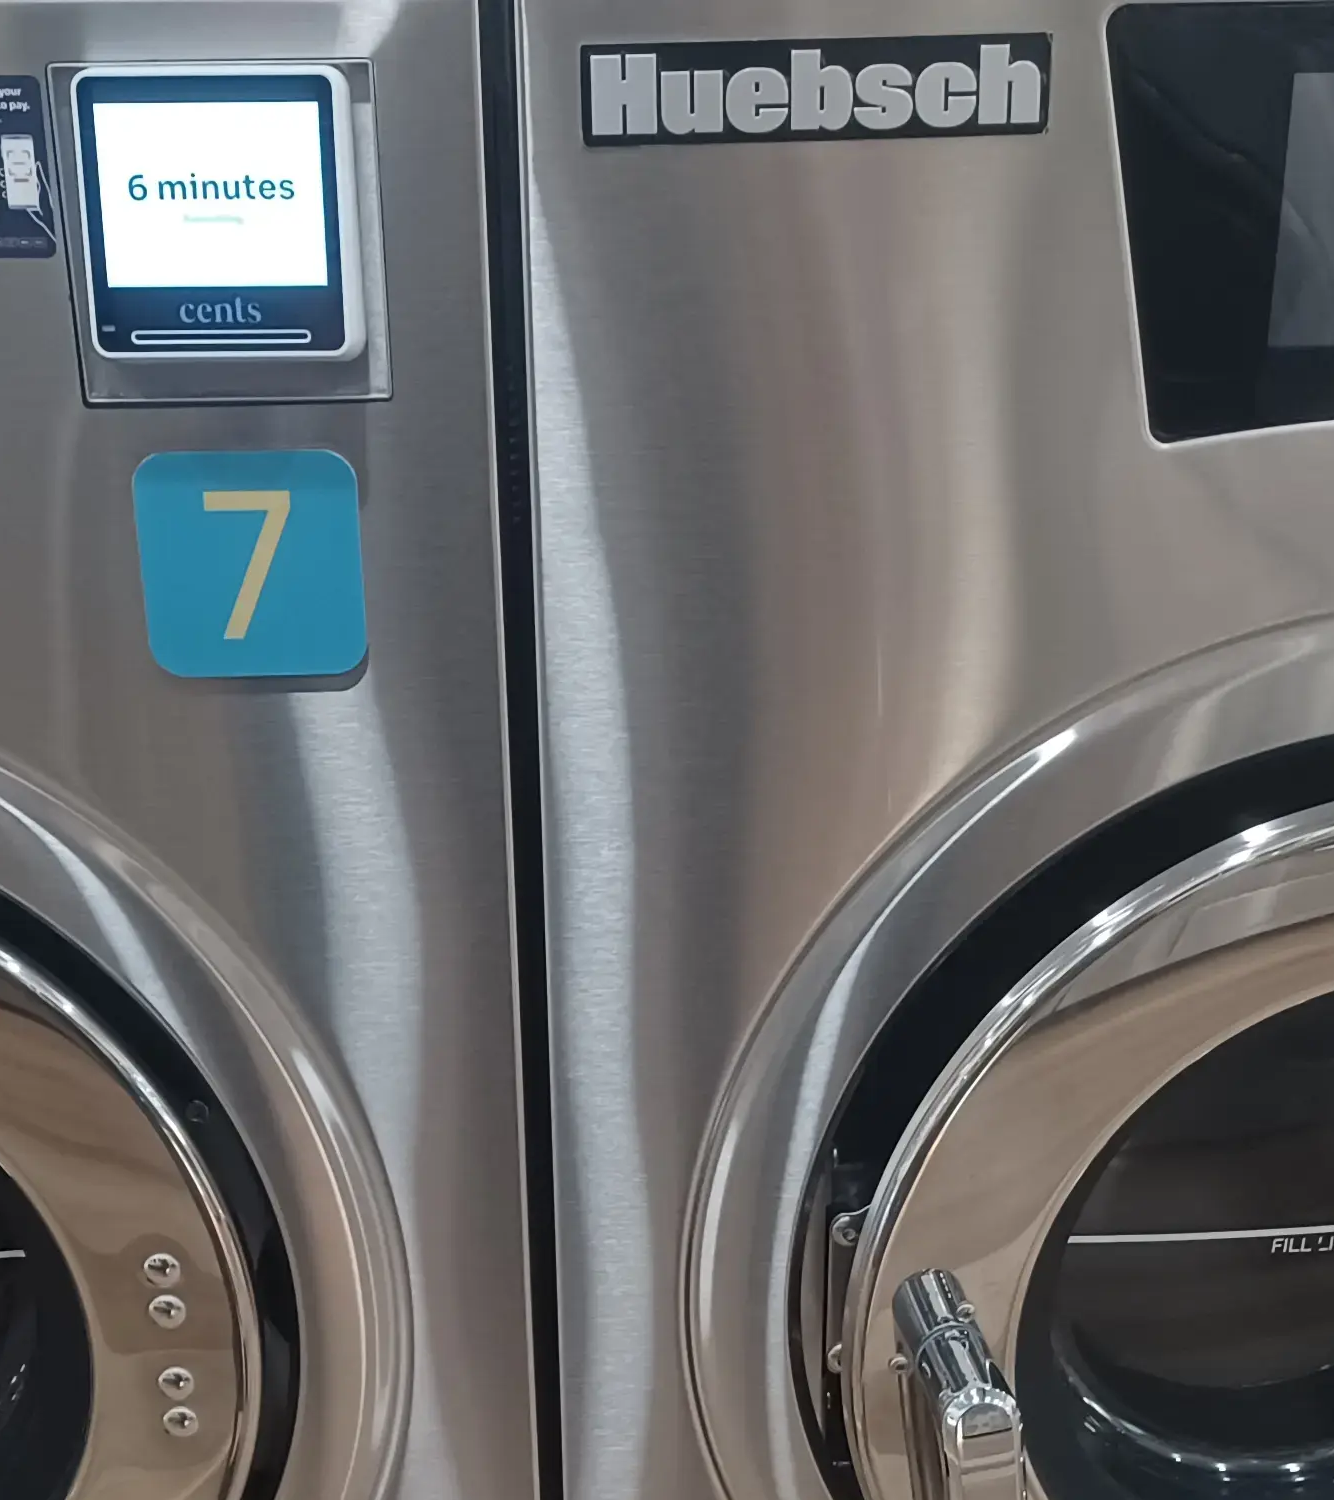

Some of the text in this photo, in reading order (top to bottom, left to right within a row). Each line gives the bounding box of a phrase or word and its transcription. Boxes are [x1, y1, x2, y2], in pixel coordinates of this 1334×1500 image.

[590, 44, 1042, 135] Huebsch
[9, 101, 31, 112] pay.
[128, 173, 295, 201] 6 minutes
[179, 296, 262, 323] cents
[202, 490, 291, 640] 7
[1271, 1237, 1313, 1254] FILL
